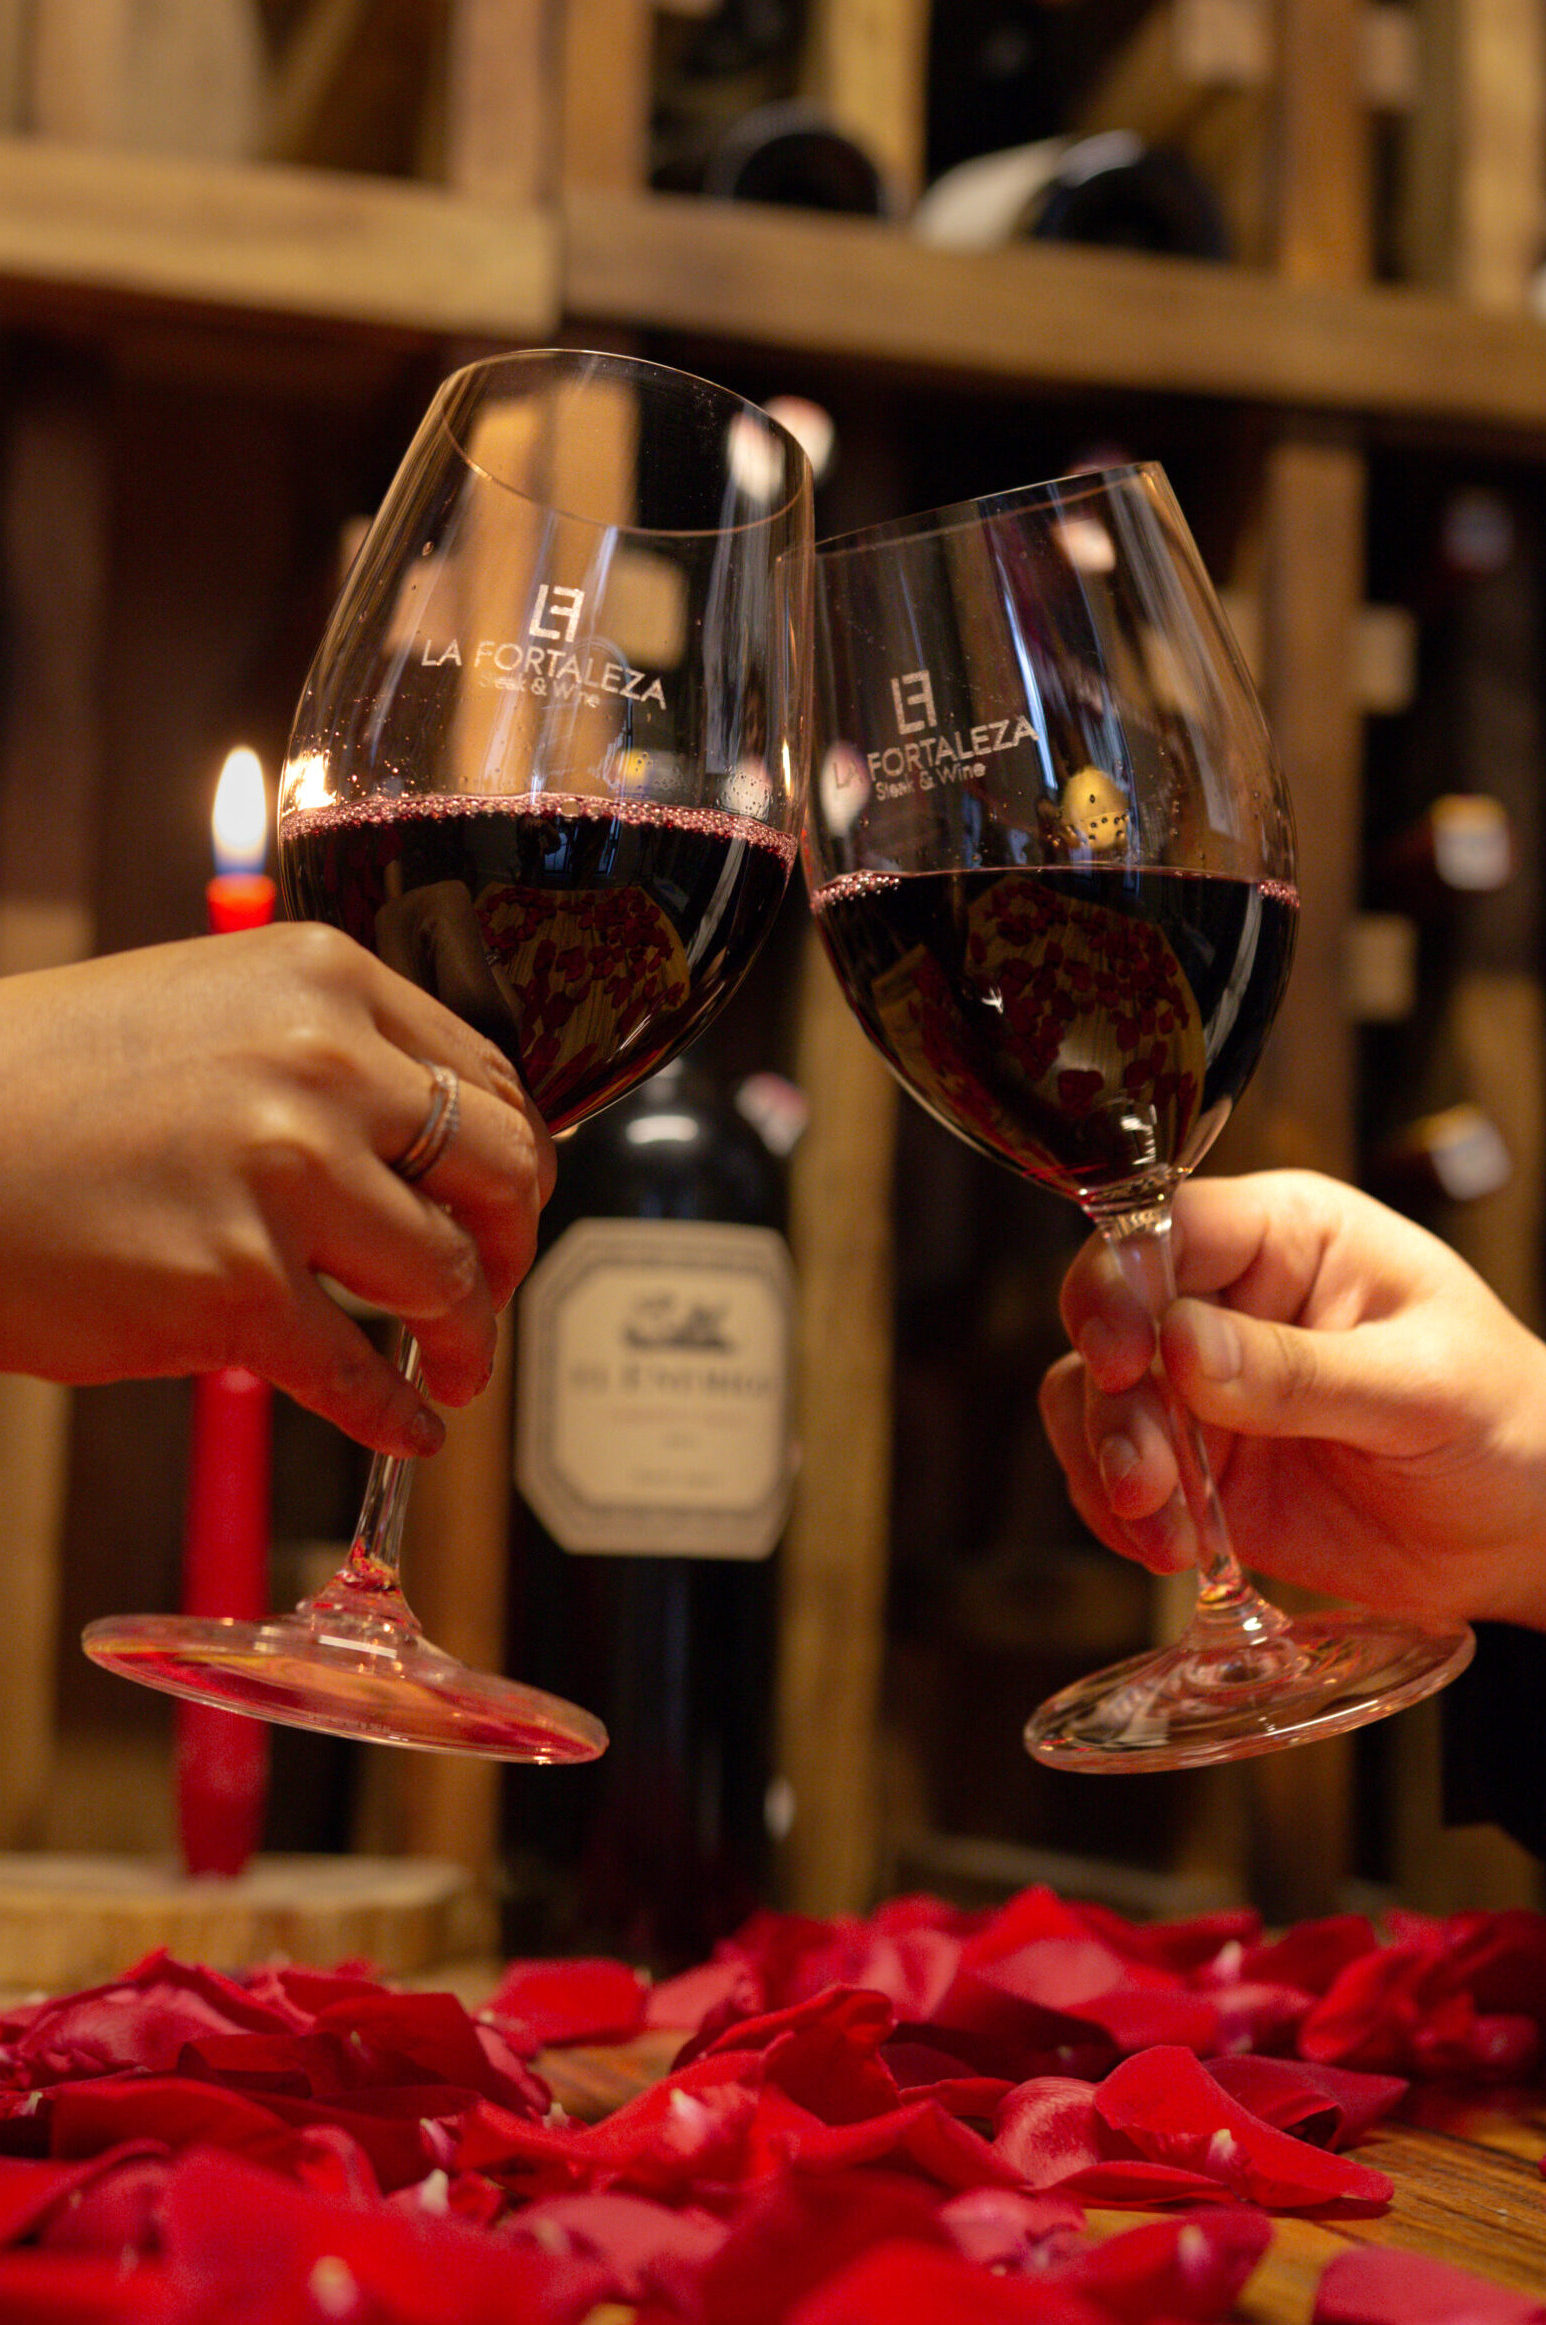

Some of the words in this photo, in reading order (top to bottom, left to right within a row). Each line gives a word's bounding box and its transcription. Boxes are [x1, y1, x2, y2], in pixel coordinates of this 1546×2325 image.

[421, 639, 462, 667] LA
[474, 640, 667, 711] FORTALEZA
[530, 676, 548, 697] &
[833, 762, 864, 790] LA
[867, 715, 1039, 781] FORTALEZA
[875, 775, 916, 801] Steak
[919, 770, 937, 791] &
[935, 762, 987, 785] Wine
